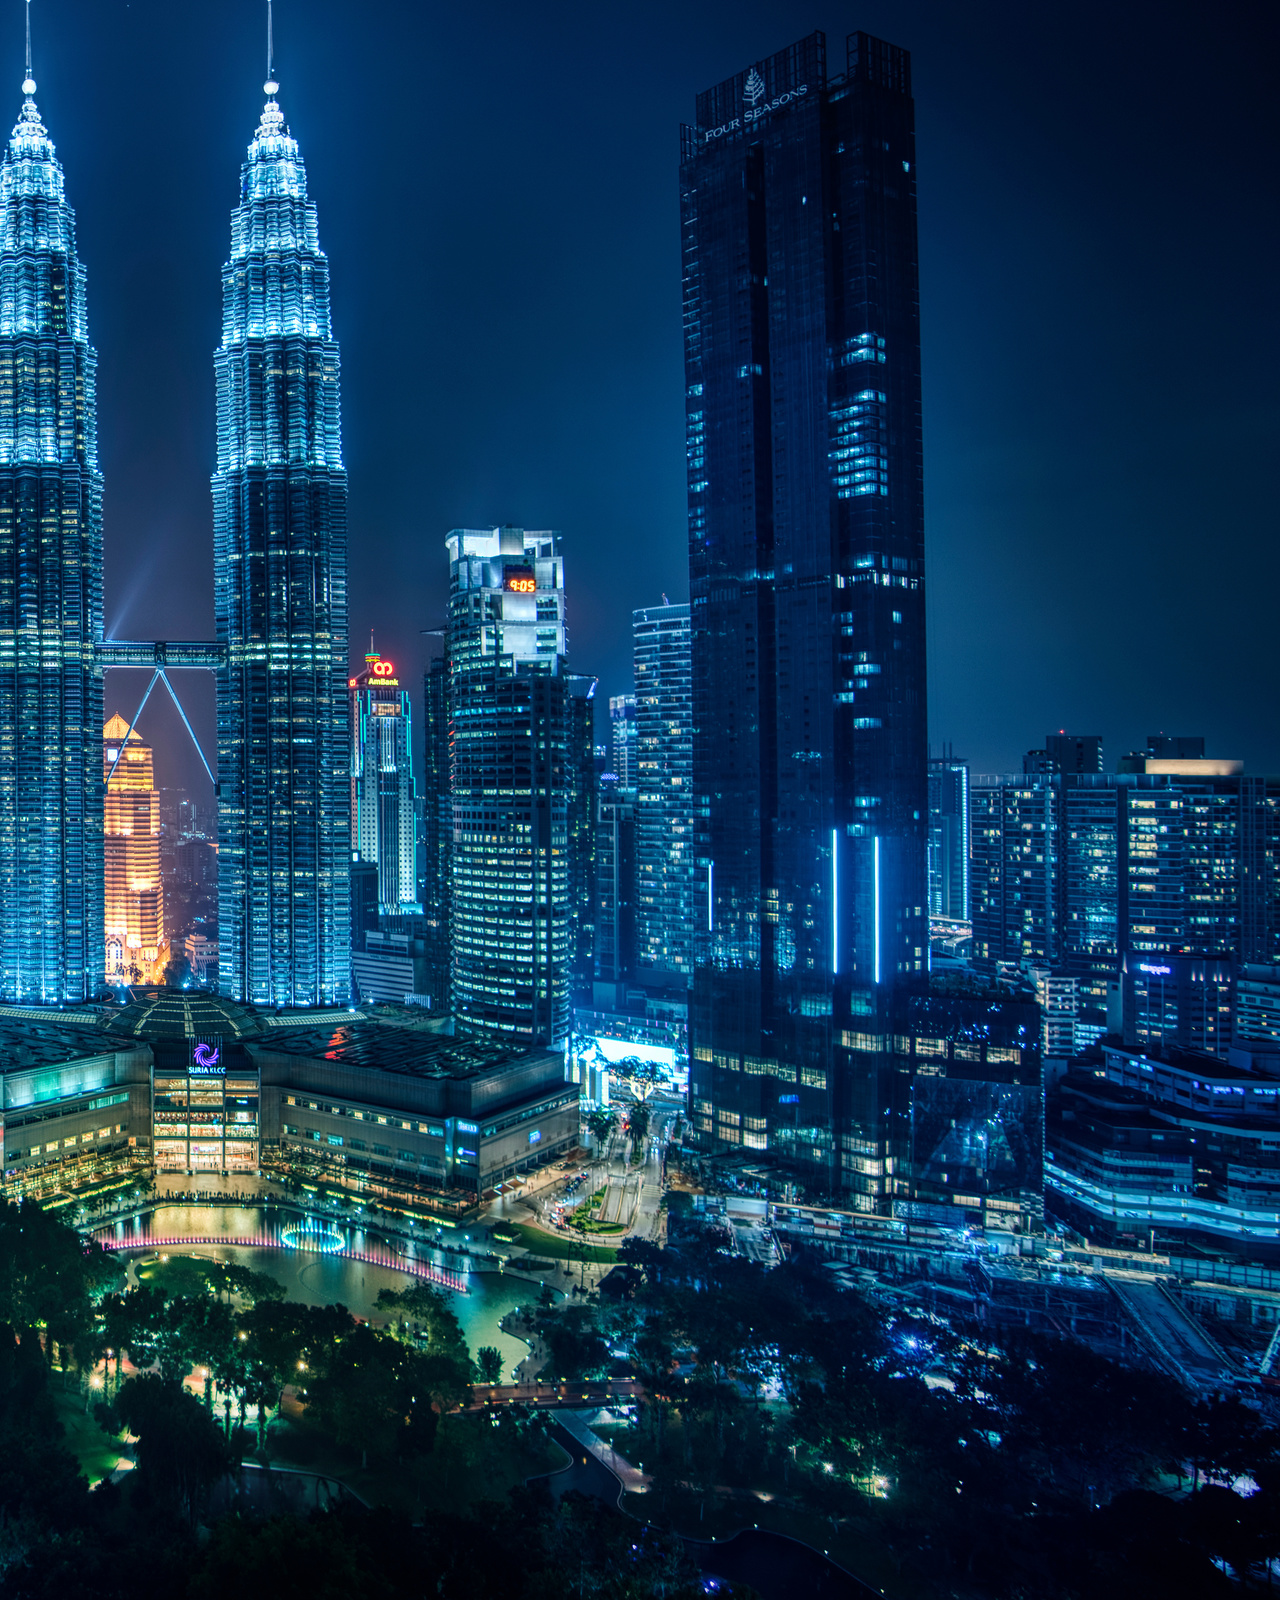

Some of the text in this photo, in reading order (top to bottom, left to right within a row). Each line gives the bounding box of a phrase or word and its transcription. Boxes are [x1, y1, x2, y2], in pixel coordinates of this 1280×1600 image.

[705, 84, 808, 142] FOUR SEASONS
[510, 579, 535, 592] 9:05
[368, 677, 399, 687] AmBank
[188, 1066, 226, 1074] SURIA KLCC
